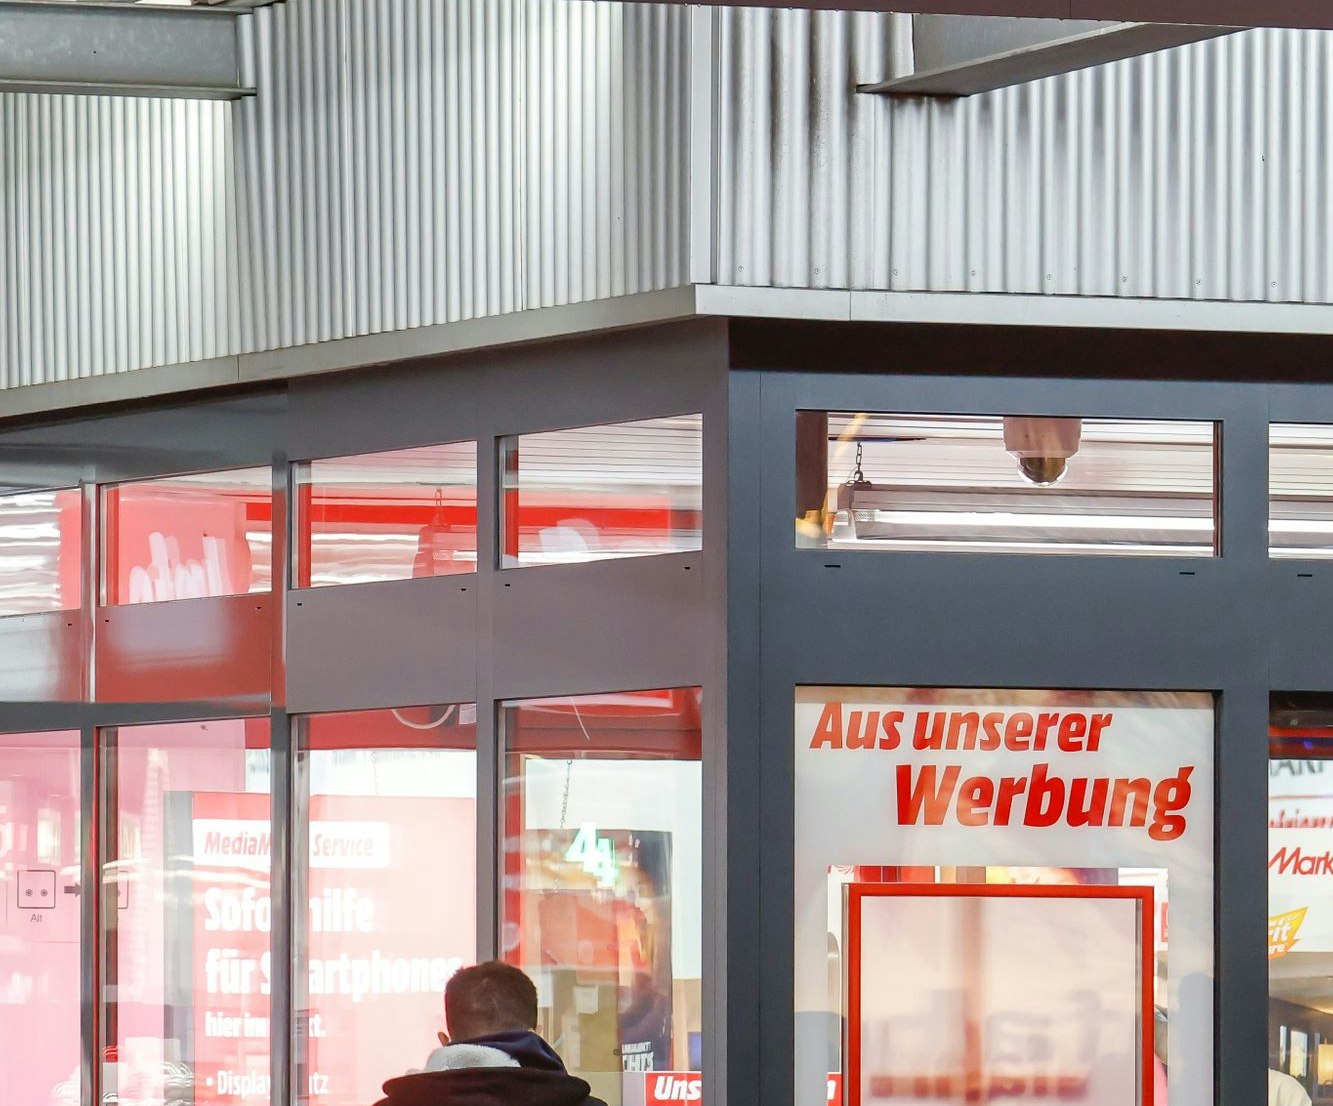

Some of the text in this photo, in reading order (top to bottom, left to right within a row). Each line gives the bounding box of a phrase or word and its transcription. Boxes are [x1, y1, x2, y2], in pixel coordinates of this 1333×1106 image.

[809, 701, 1113, 753] Aus unserer
[895, 763, 1195, 841] Werbung
[312, 833, 374, 857] Service
[205, 948, 256, 994] für
[205, 1011, 241, 1038] hier
